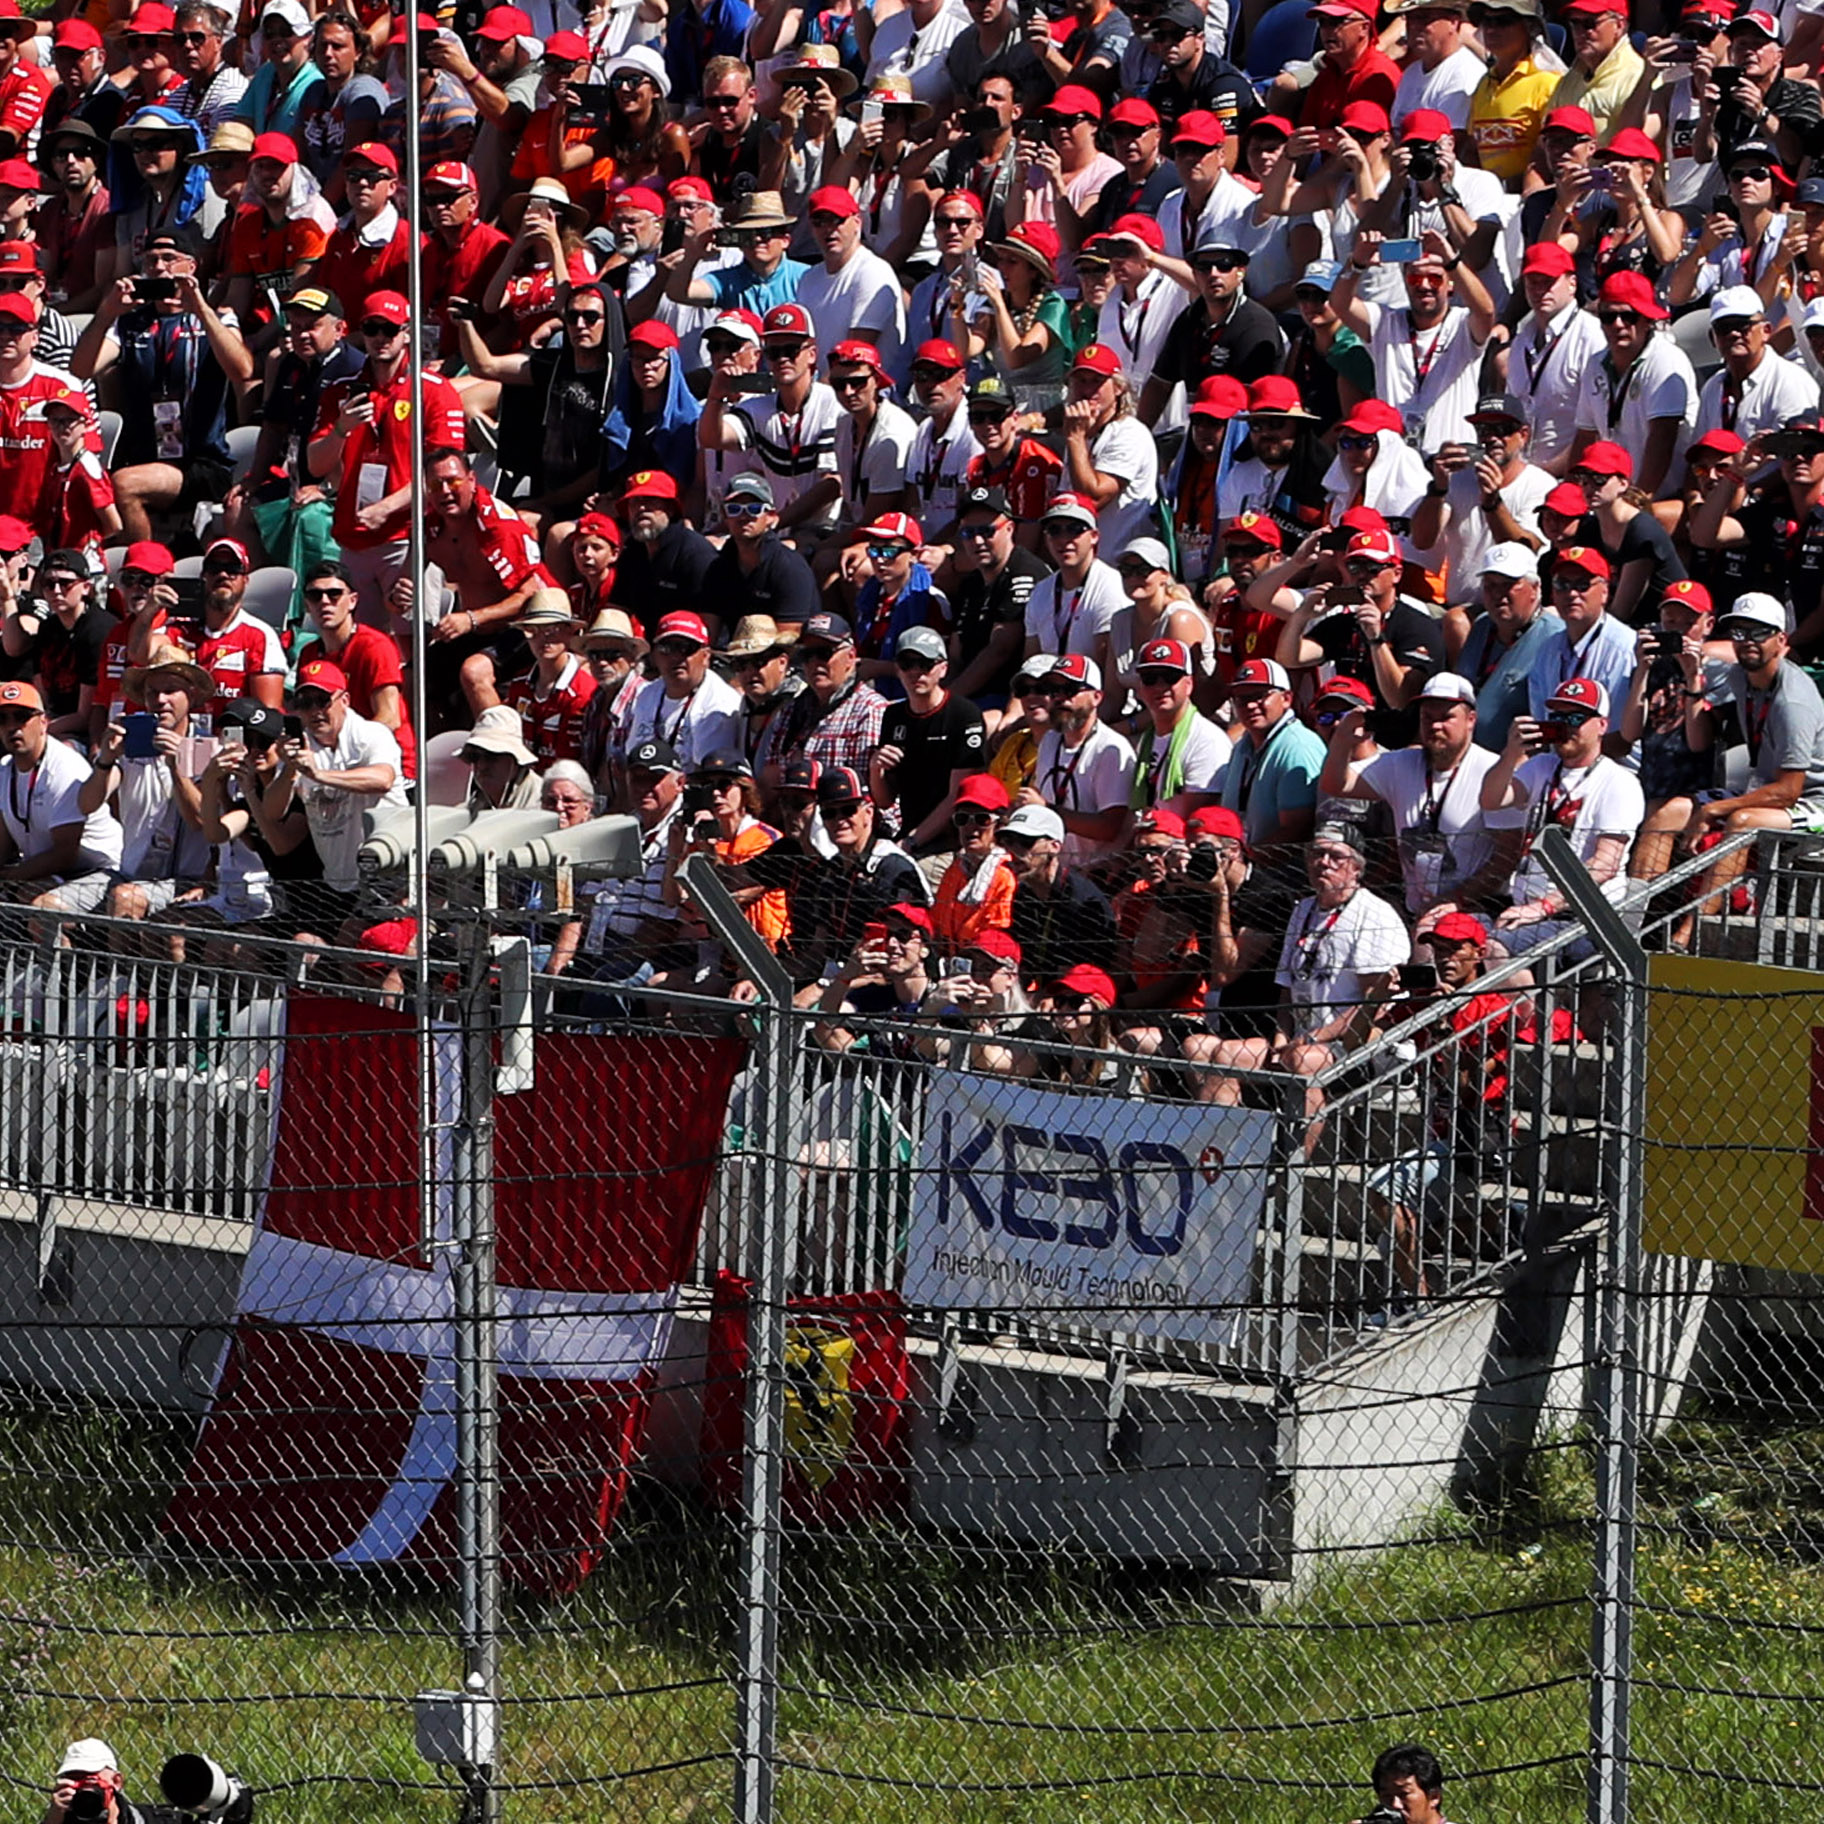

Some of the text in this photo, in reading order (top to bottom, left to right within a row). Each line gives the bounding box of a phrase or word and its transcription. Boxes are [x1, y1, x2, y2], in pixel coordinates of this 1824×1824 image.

[937, 1110, 1194, 1257] KEBO
[933, 1246, 1190, 1305] Injection Mould Technology
